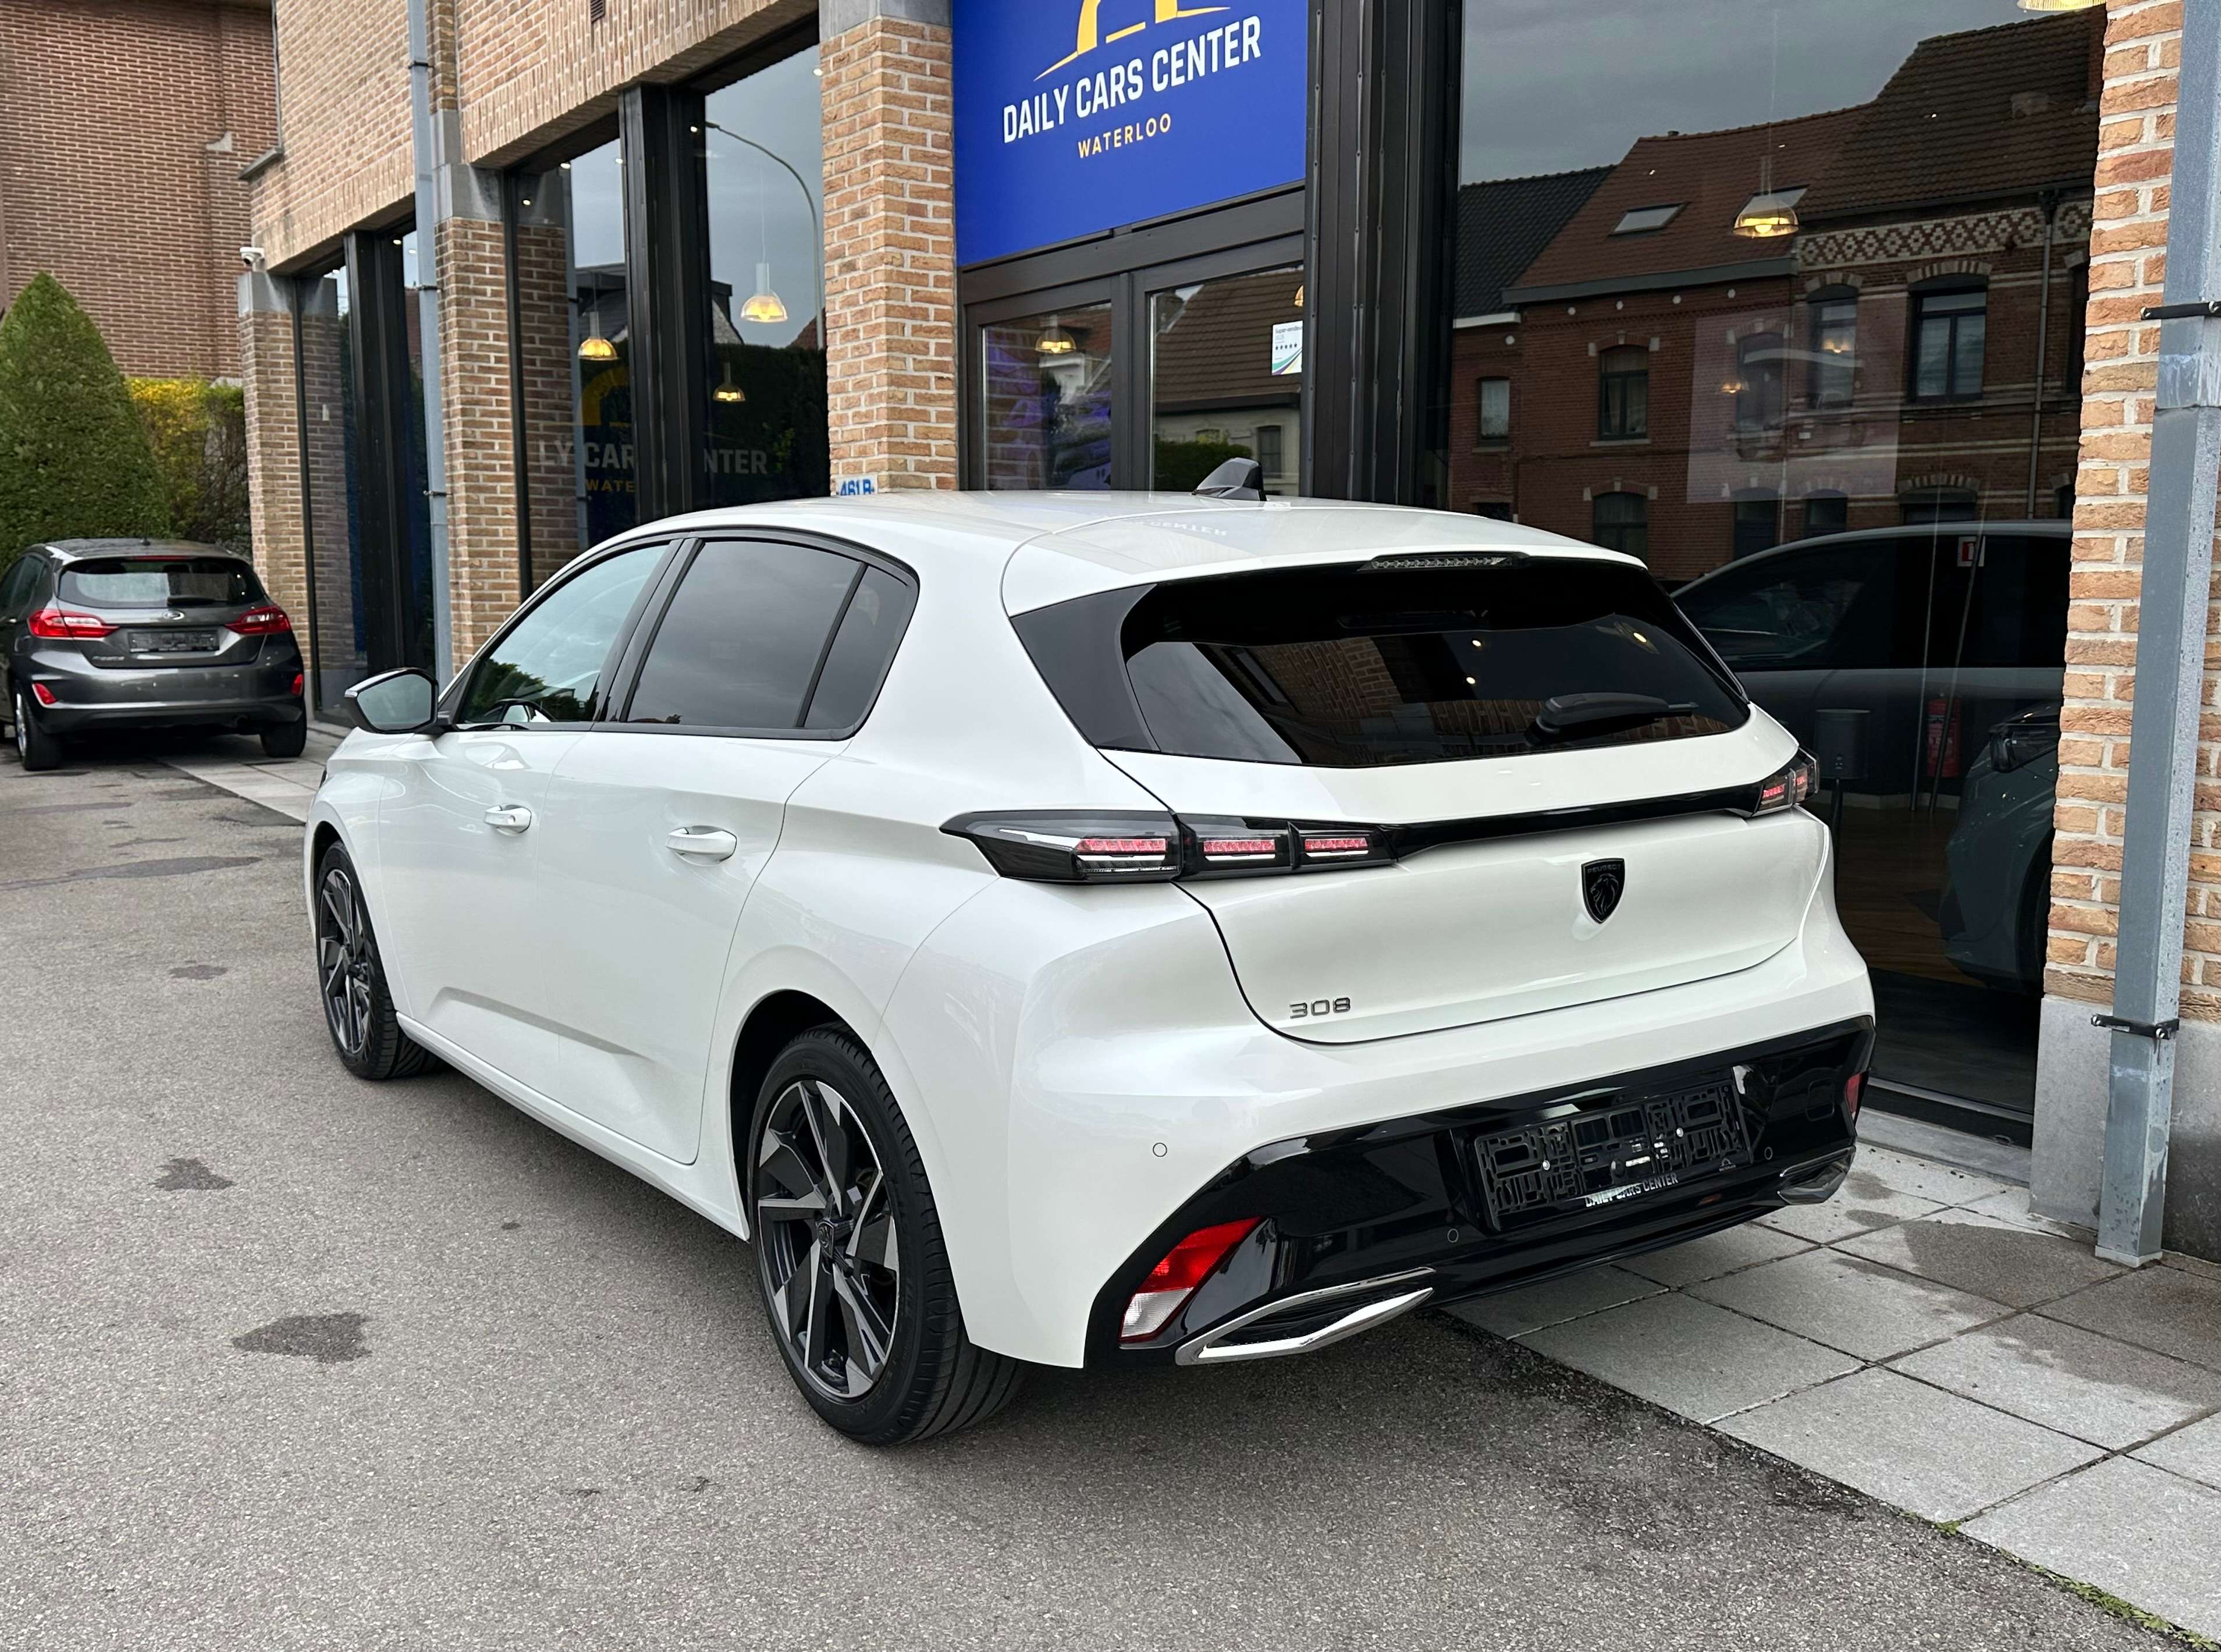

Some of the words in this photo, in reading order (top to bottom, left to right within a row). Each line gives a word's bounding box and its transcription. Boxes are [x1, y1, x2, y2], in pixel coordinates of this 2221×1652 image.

[1003, 84, 1069, 143] DAILY
[1076, 58, 1143, 118] CARS
[1152, 15, 1261, 93] CENTER
[1078, 113, 1171, 159] WATERLOO
[1289, 997, 1351, 1019] 308
[1643, 1172, 1679, 1192] CENTER
